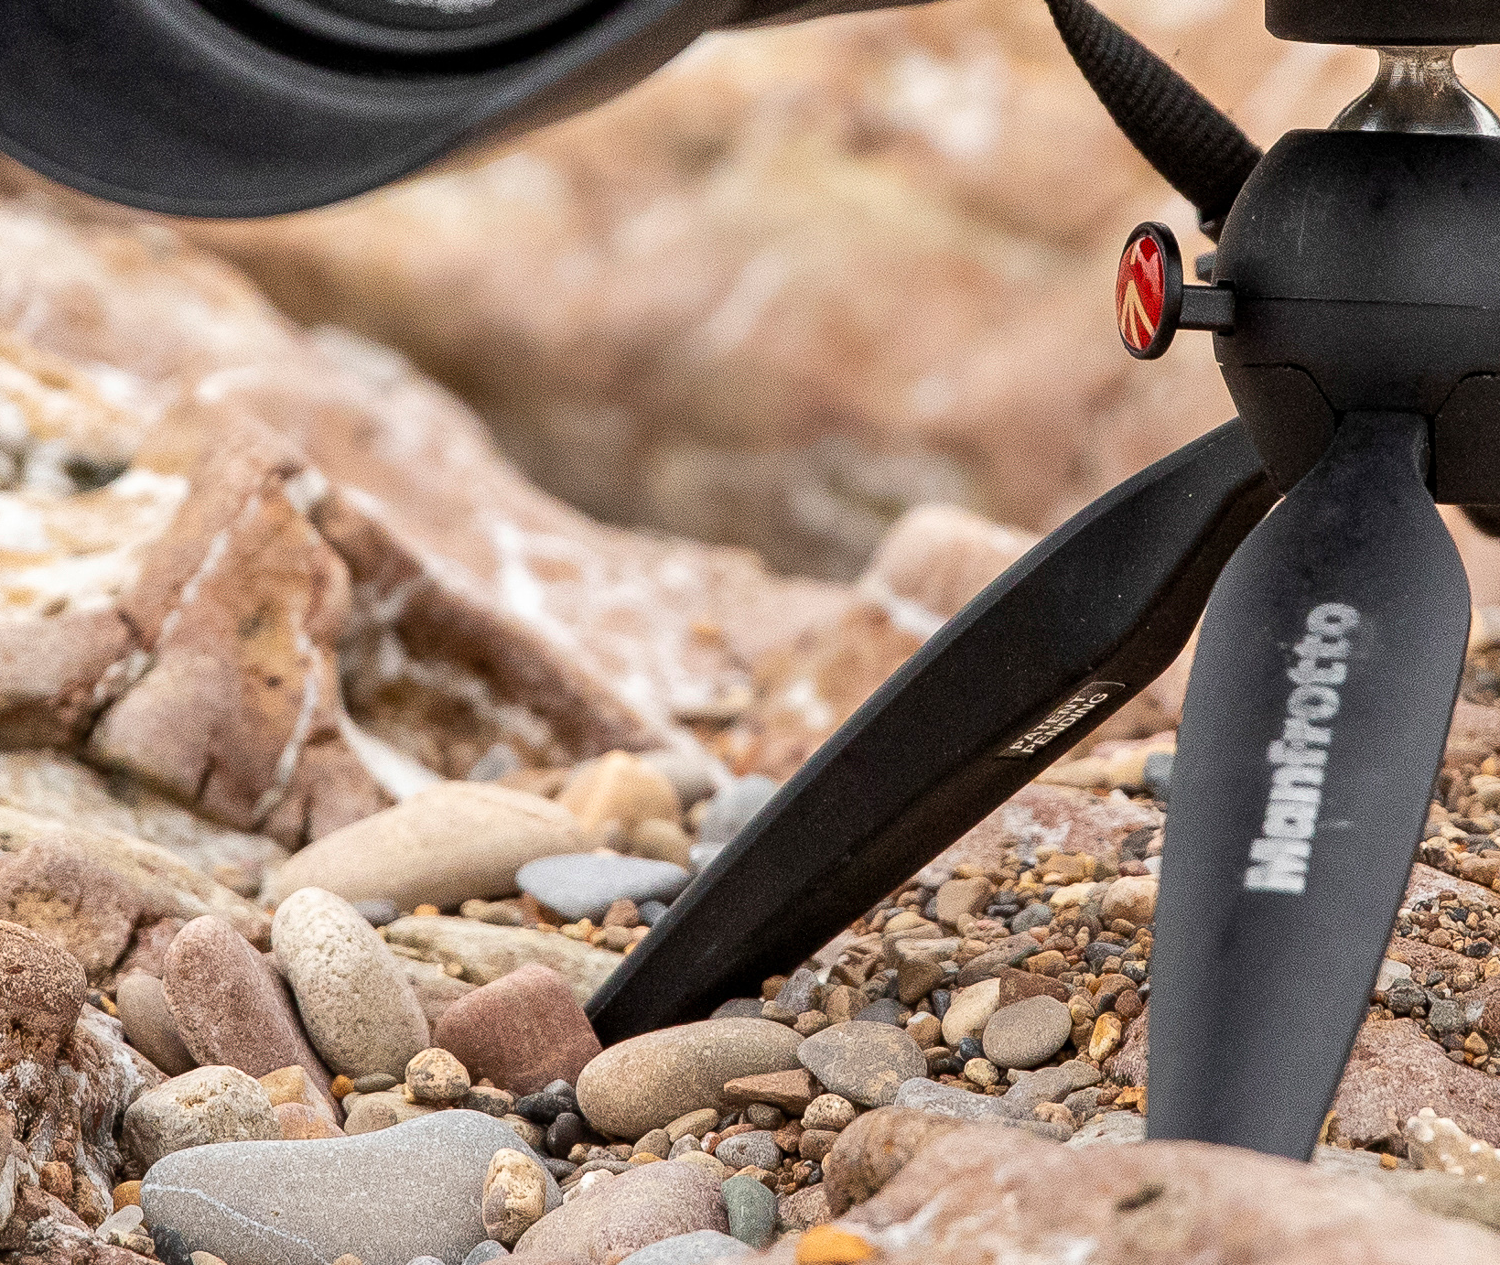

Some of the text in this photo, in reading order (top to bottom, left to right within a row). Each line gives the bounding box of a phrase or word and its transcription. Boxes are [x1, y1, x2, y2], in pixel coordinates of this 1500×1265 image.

[1009, 695, 1086, 750] PATENT
[1021, 692, 1109, 754] PENDING
[1244, 603, 1360, 895] Manfrotto
